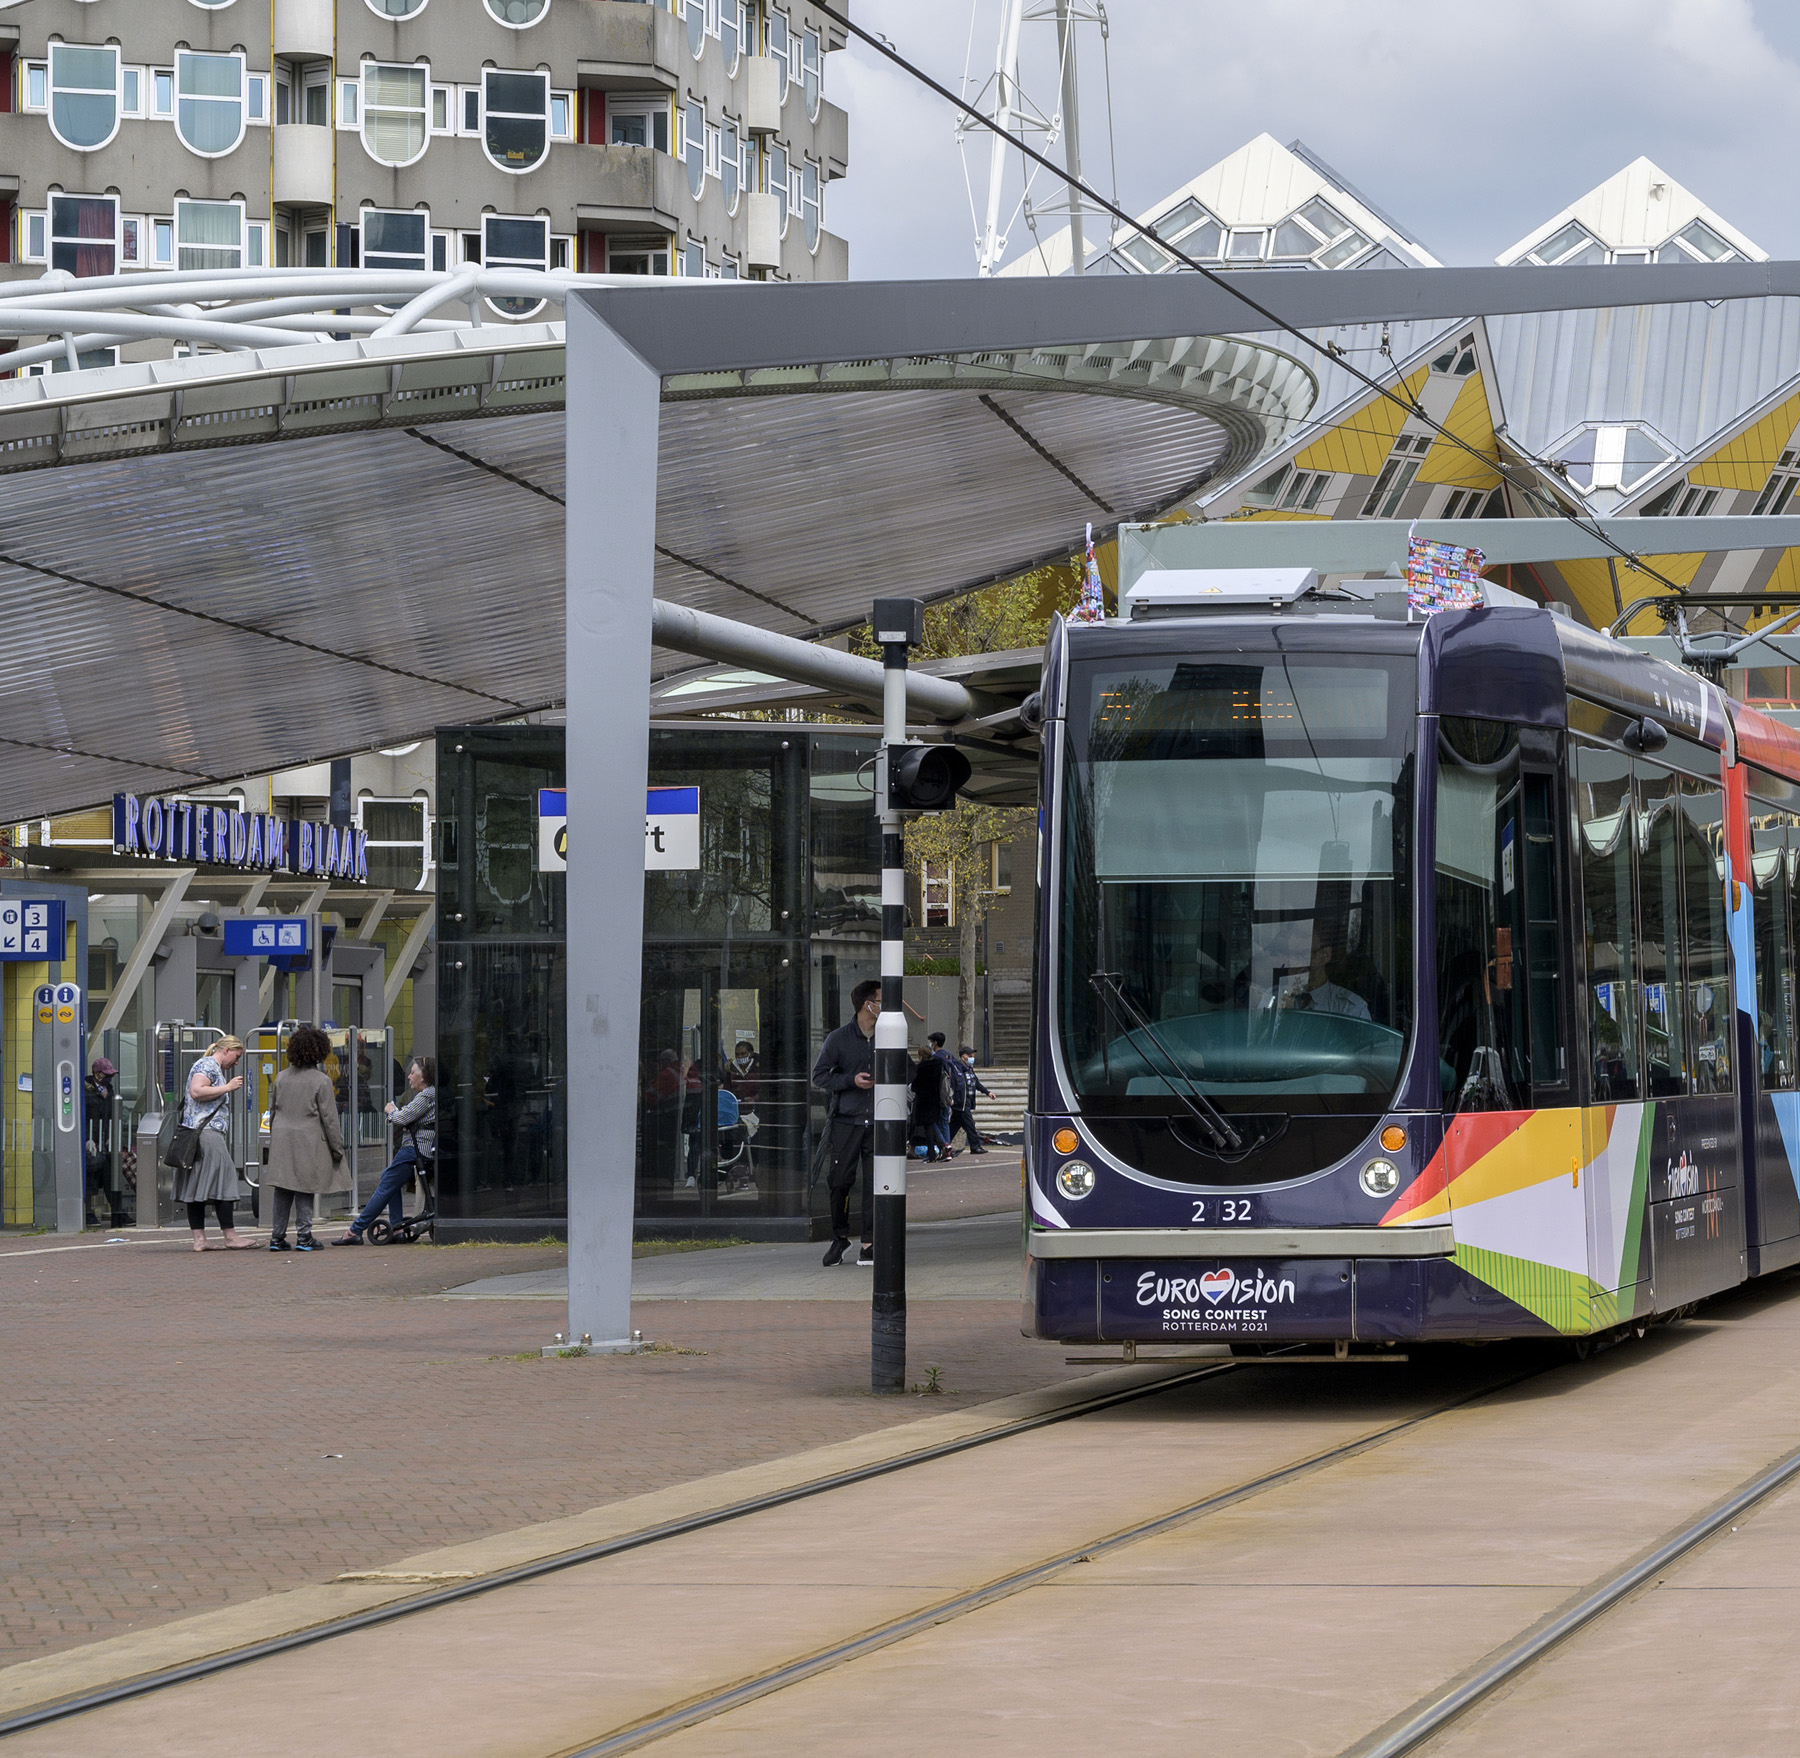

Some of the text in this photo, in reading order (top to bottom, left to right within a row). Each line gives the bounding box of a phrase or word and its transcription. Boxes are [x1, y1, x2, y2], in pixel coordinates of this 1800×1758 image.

[114, 793, 369, 881] ROTTERDAM BLAAK
[32, 912, 40, 925] 3
[31, 938, 41, 950] 4
[1163, 1309, 1268, 1320] SONG CONTEST
[1163, 1321, 1268, 1331] ROTTERDAM 2021
